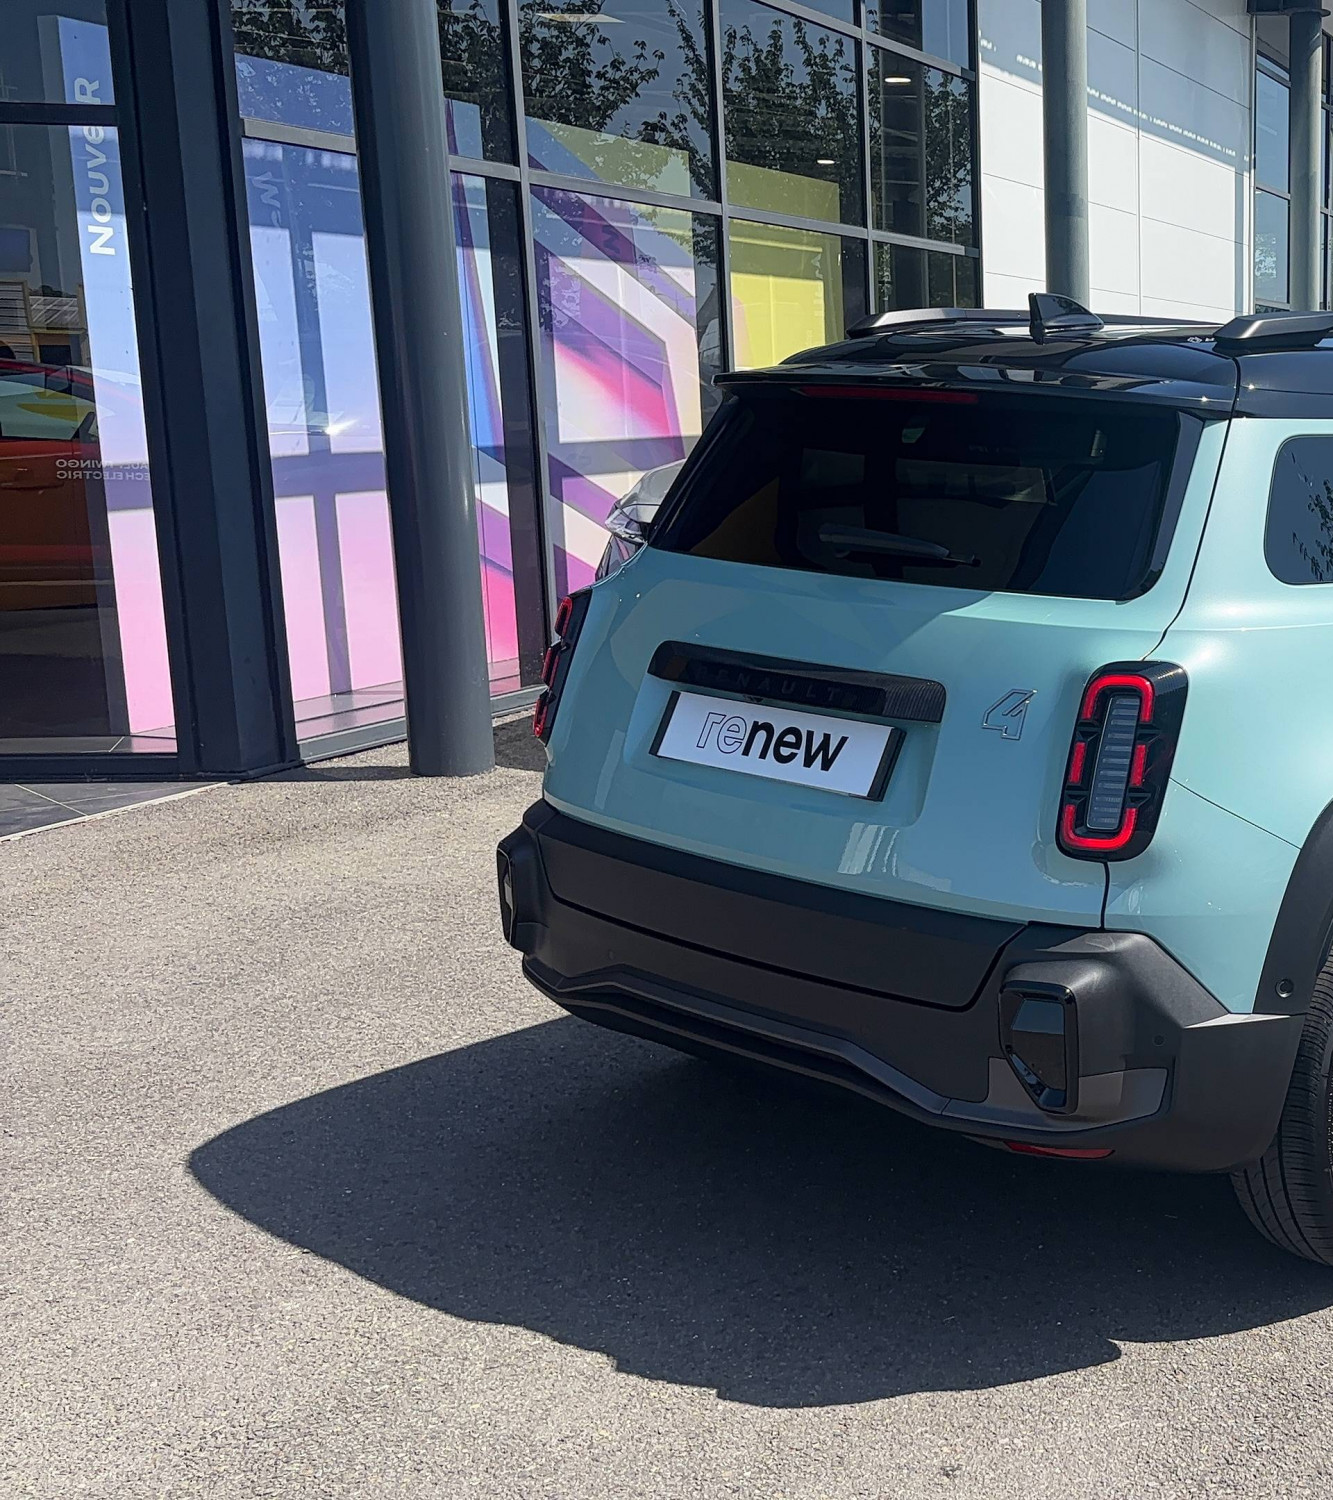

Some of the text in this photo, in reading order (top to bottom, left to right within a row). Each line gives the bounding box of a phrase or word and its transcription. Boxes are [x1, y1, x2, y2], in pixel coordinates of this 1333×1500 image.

[695, 664, 841, 701] RENAULT
[981, 689, 1037, 740] 4
[695, 711, 849, 772] renew
